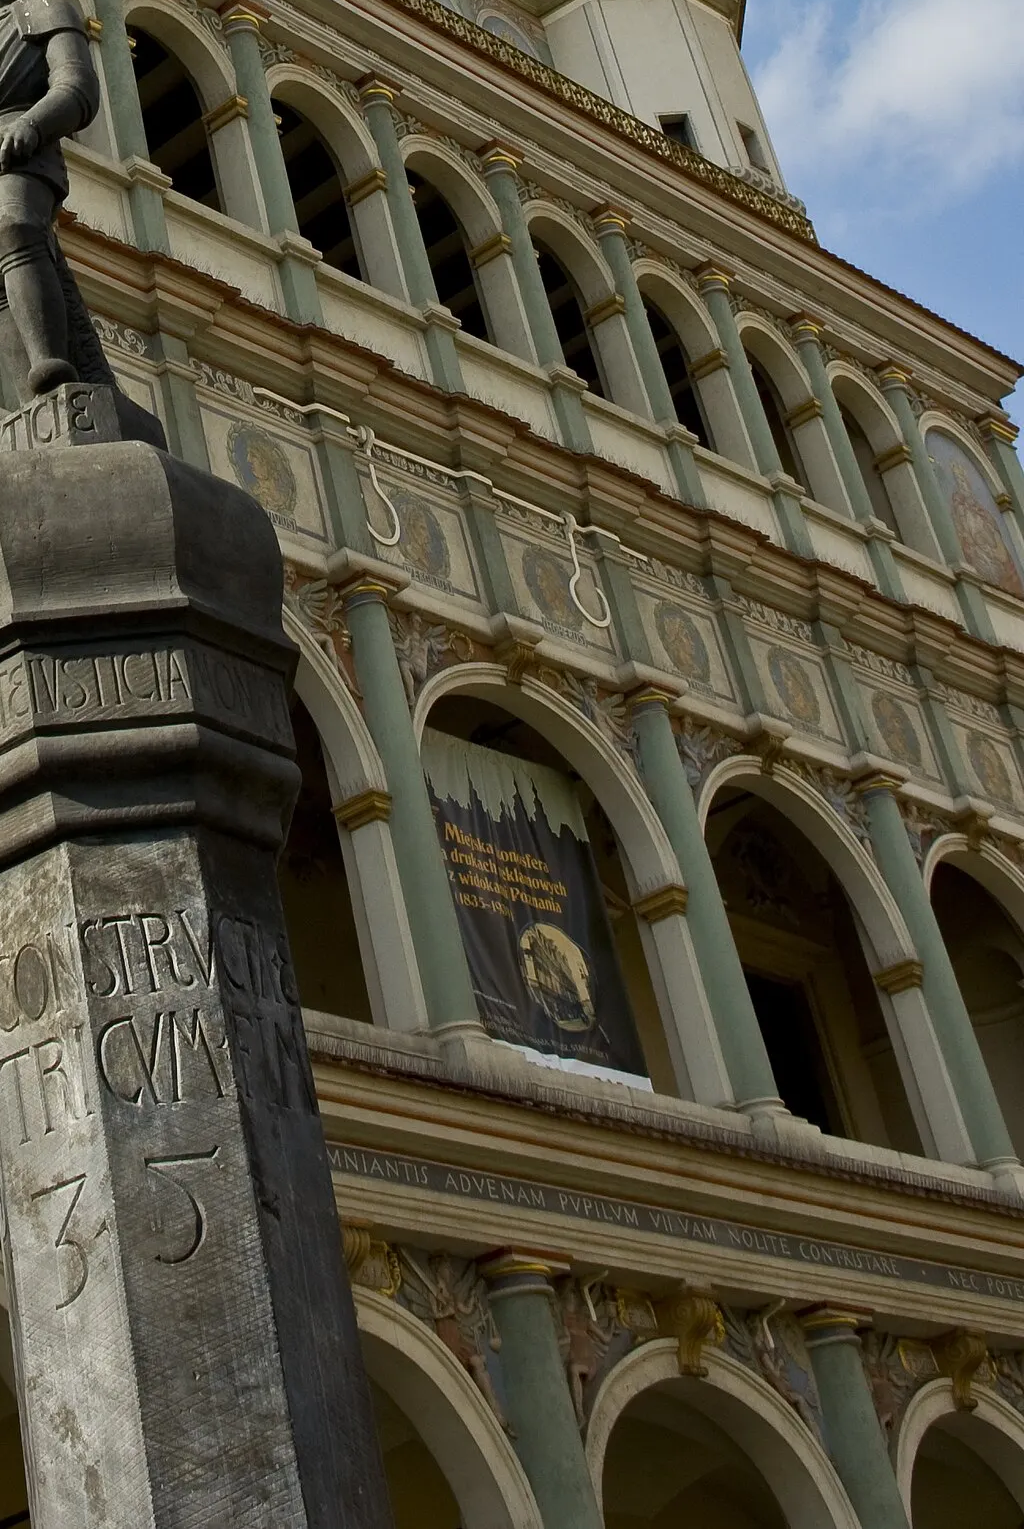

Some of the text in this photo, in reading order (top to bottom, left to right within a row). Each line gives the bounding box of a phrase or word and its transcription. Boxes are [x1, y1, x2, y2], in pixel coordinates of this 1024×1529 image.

[444, 821, 495, 855] Miejska
[509, 886, 563, 915] Poznania
[445, 1172, 546, 1209] ADVENAM
[558, 1191, 640, 1227] PVPILVM
[727, 1227, 792, 1256] NOLITE
[947, 1269, 980, 1292] NEC
